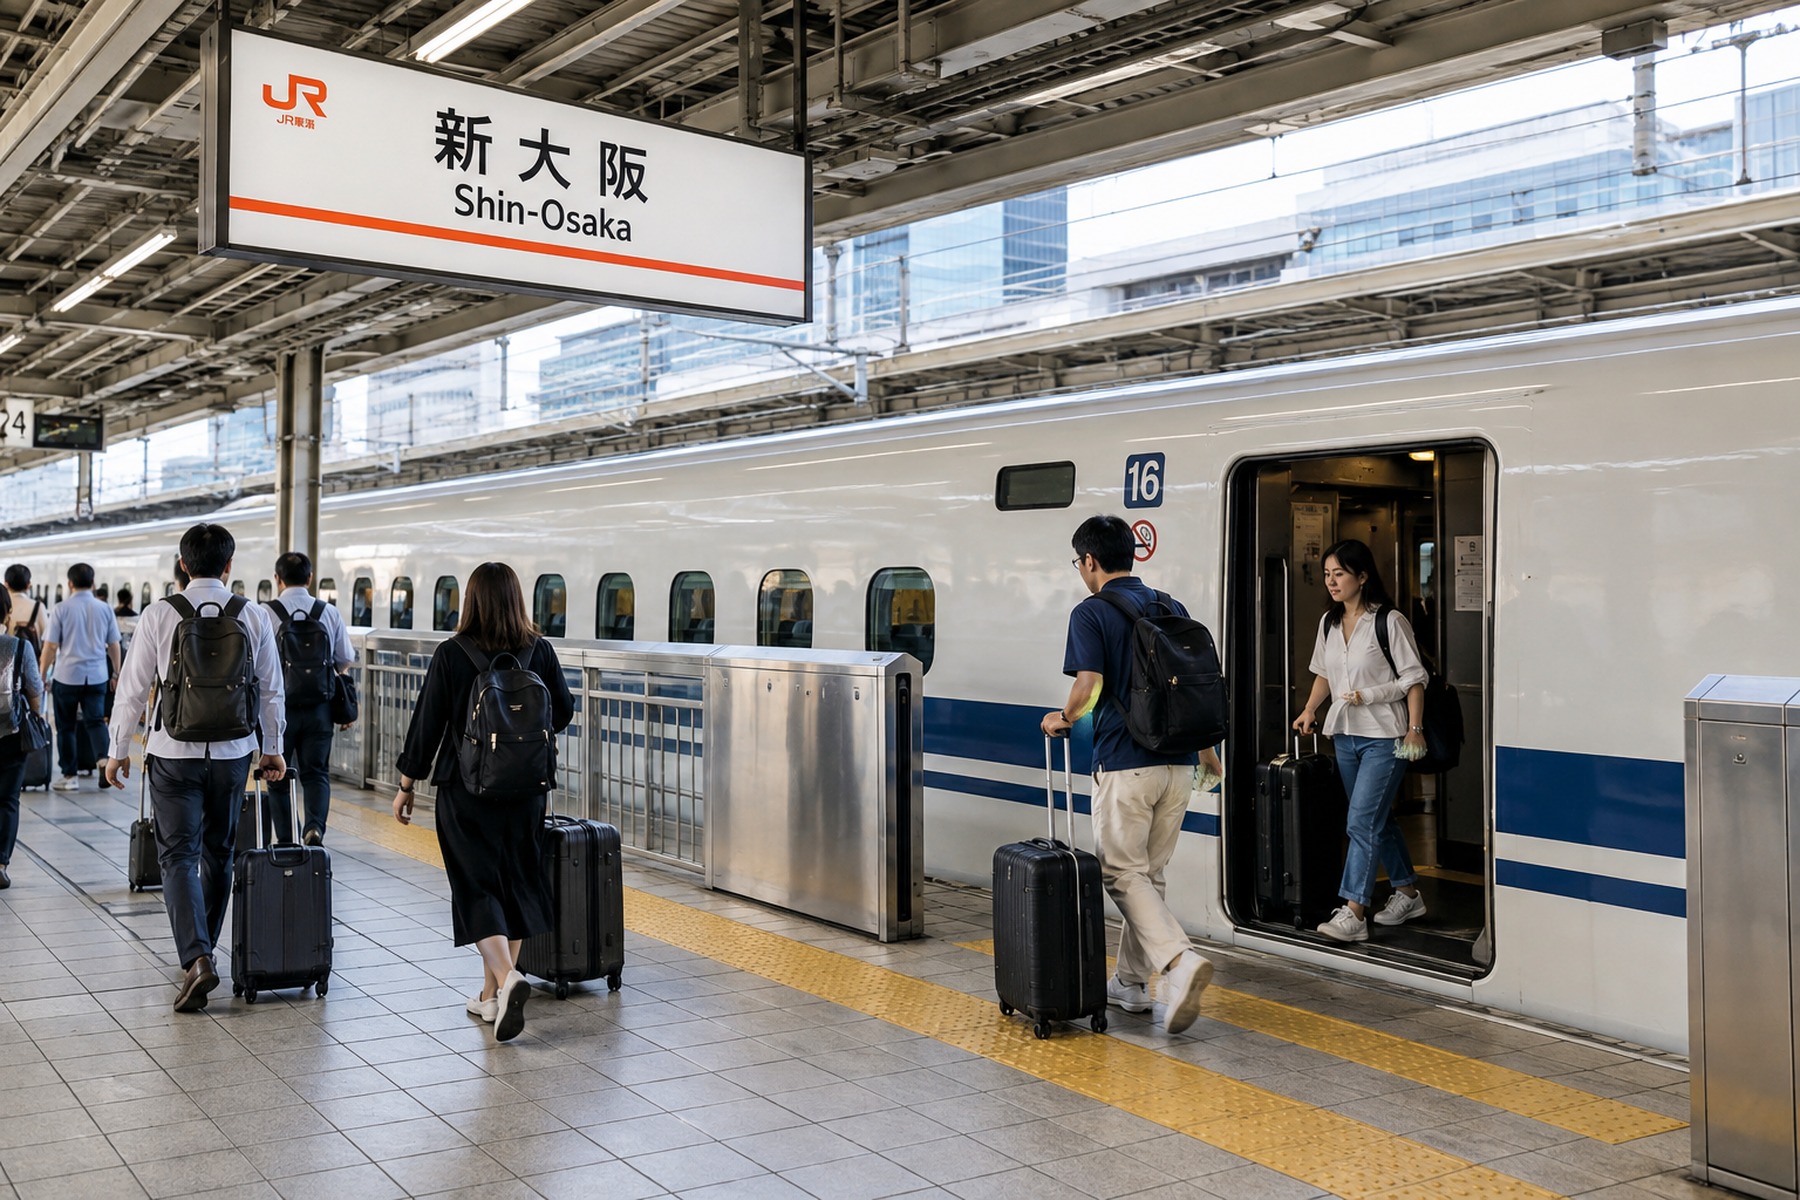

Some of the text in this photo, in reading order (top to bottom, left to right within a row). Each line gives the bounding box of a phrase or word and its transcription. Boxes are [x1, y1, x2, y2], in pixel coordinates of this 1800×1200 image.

[262, 73, 327, 118] JR
[434, 107, 648, 203] 新大阪
[454, 183, 632, 242] Shin-Osaka
[1128, 460, 1160, 501] 16
